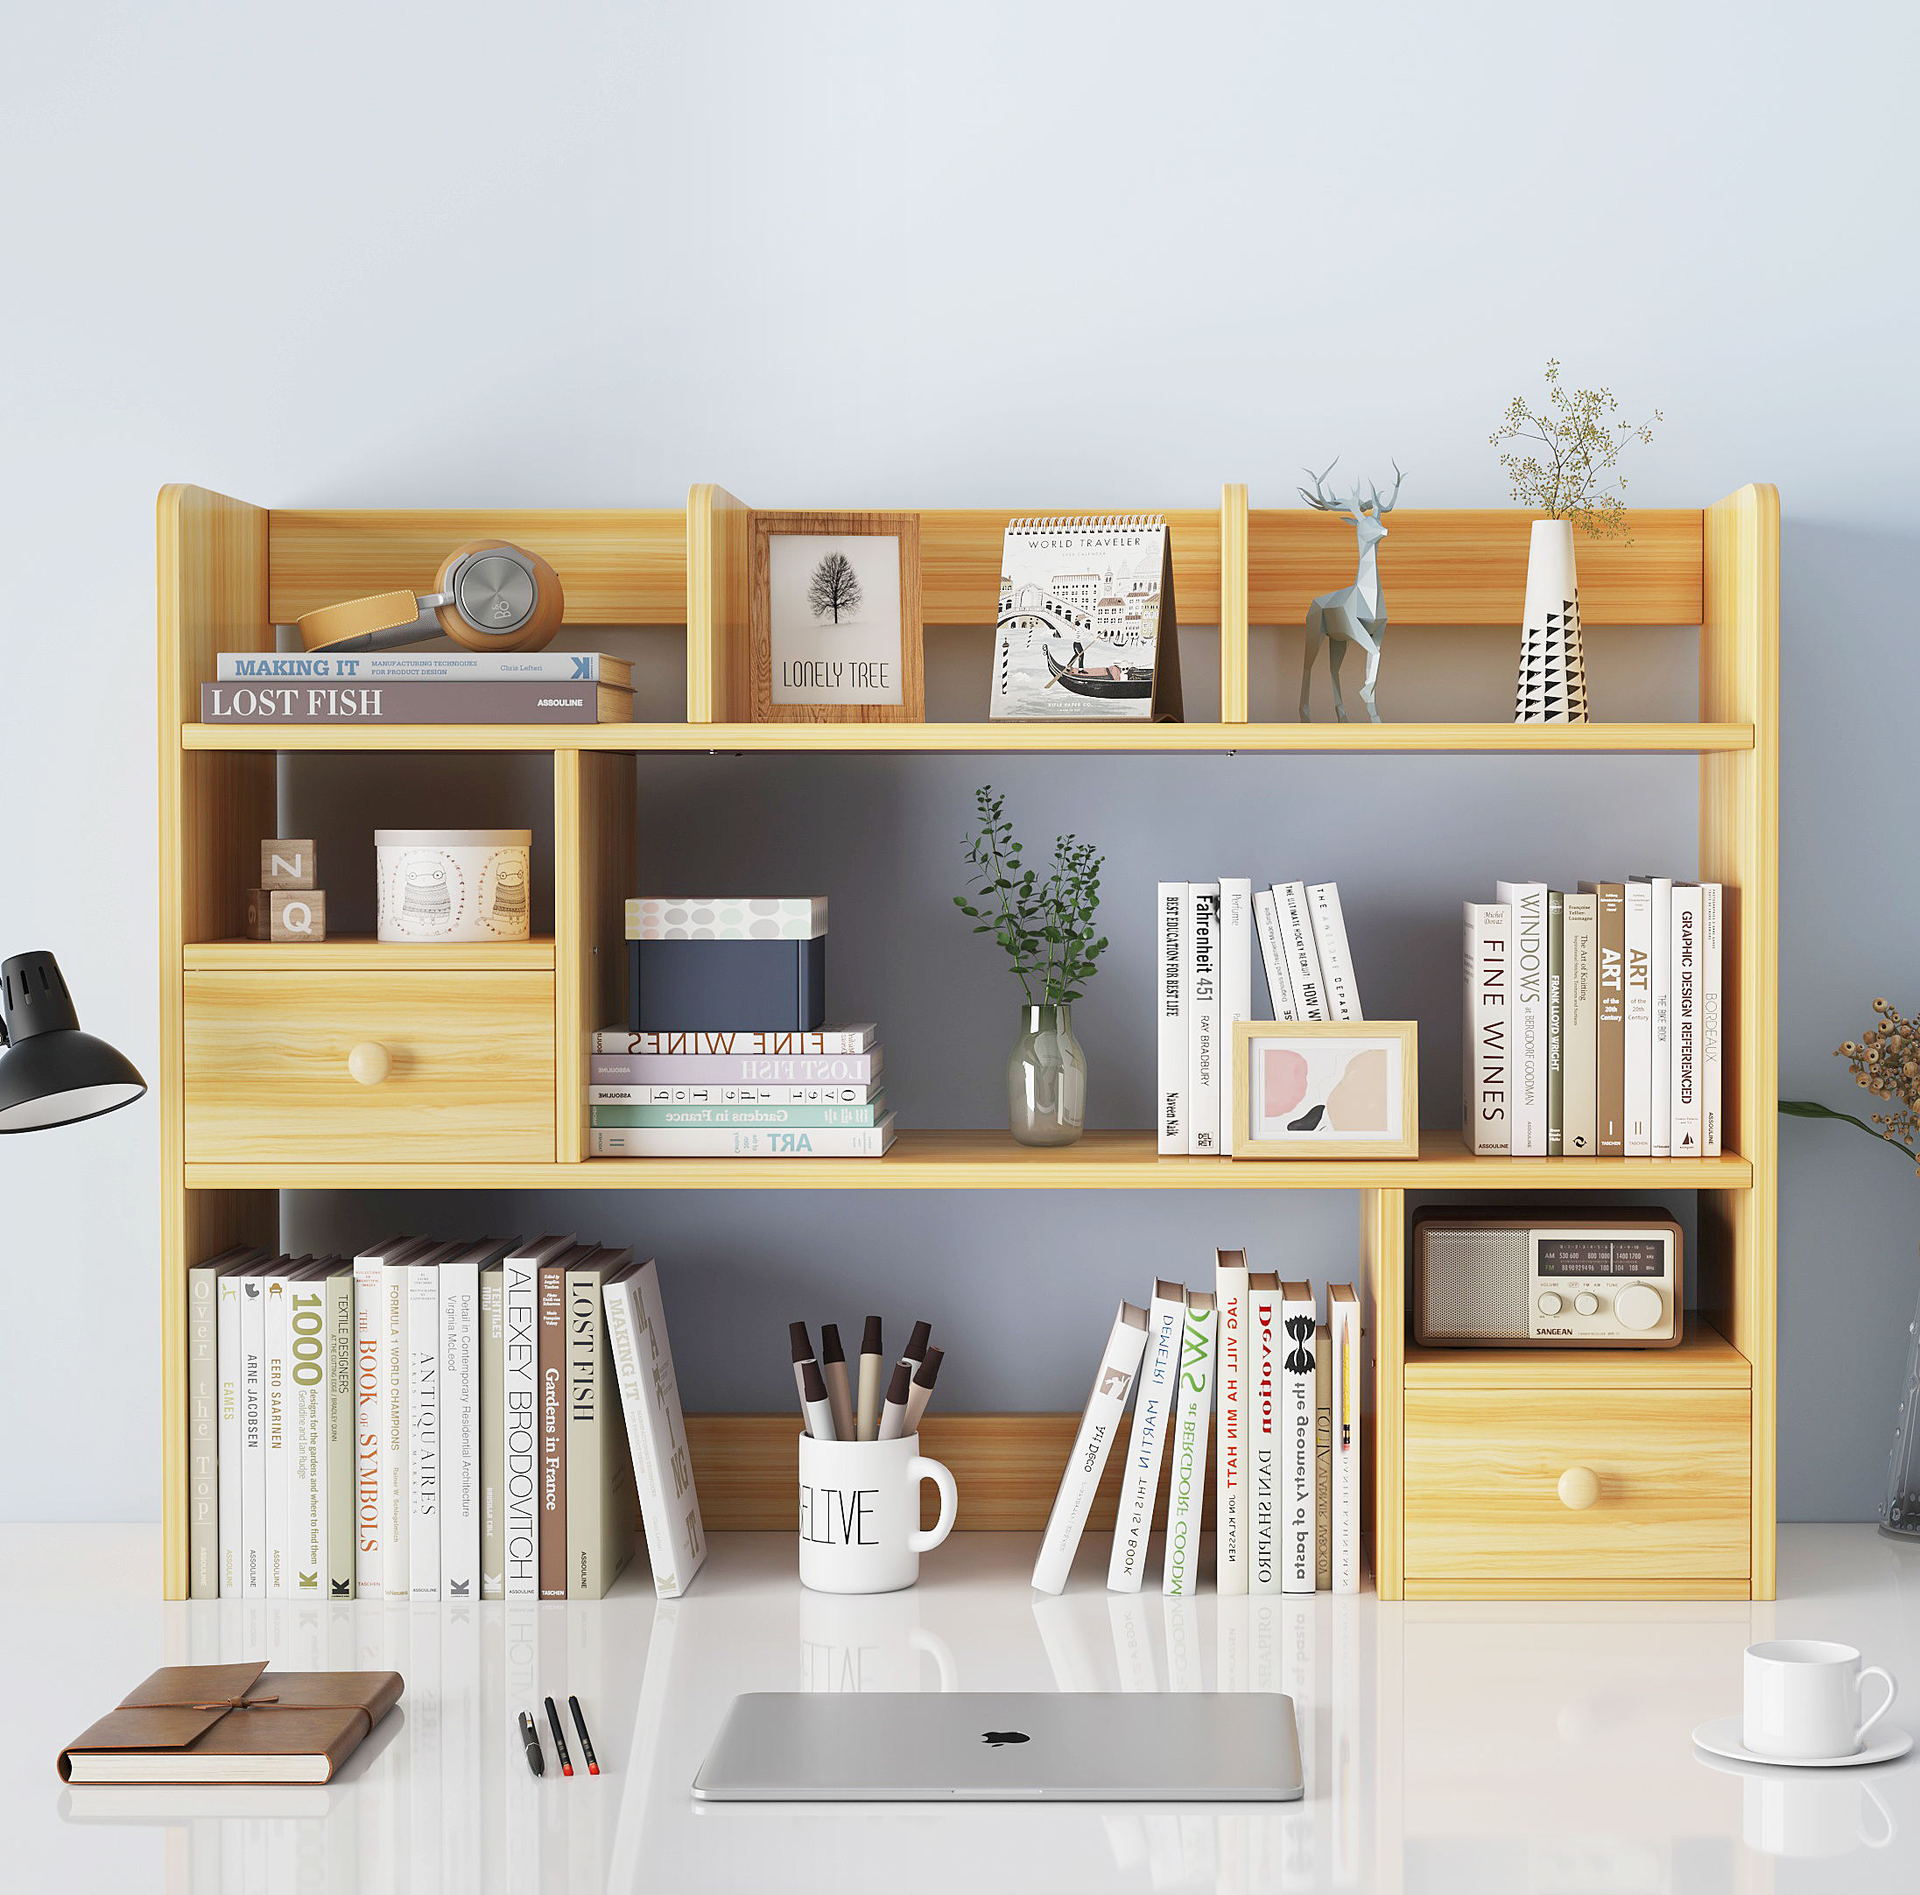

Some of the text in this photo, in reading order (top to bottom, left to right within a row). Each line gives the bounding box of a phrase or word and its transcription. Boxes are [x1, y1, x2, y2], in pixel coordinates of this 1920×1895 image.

[1028, 538, 1141, 549] WORLD TRAVELER
[211, 689, 384, 717] LOST FISH
[235, 660, 360, 676] MAKING IT
[500, 664, 518, 672] Chris
[537, 699, 583, 707] ASSOULINE
[783, 661, 891, 689] LONELY TREE
[283, 901, 313, 935] Q
[1231, 894, 1242, 926] Perfume
[1316, 888, 1327, 909] THE
[1166, 896, 1180, 1017] BEST EDUCATION FOR BEST LIFE
[1196, 895, 1213, 1001] Fahrenheit 451
[1602, 947, 1621, 991] ART
[1630, 948, 1648, 990] ART
[1681, 911, 1692, 967] GRAPHIC
[1302, 983, 1318, 1006] HOW
[1520, 893, 1540, 1106] WINDOWS BERGDORF GOODMAN
[1551, 975, 1560, 1072] FRANK LLOYD WRIGHT
[1658, 994, 1667, 1007] THE
[1681, 971, 1692, 1017] DESIGN
[1704, 993, 1718, 1064] BORDEAUX
[1200, 1015, 1210, 1087] RAY BRADBURY
[1483, 940, 1504, 1121] FINE WINES
[1681, 1022, 1692, 1104] REFERENCED
[1166, 1092, 1179, 1137] Naveen Naik
[292, 1292, 323, 1386] 1000
[338, 1294, 349, 1394] TEXTILE DESIGNERS
[446, 1295, 457, 1372] Virginia McLeod
[492, 1286, 502, 1338] TEXTILES
[1536, 1328, 1573, 1336] SANGEAN
[390, 1284, 400, 1451] FORMULA WORLD CHAMPIONS
[572, 1282, 594, 1423] LOST FISH
[608, 1298, 640, 1401] MAKING IT
[224, 1382, 234, 1420] EAMES
[247, 1354, 257, 1448] ARNE JACOBSEN
[271, 1358, 282, 1450] EERO SAARINEN
[299, 1390, 307, 1425] Geraldine
[359, 1310, 379, 1552] THE BOOK OF SYMBOLS
[416, 1352, 436, 1515] ANTIQUAIRES
[459, 1295, 472, 1517] Detail Contemporary Residential Architecture
[508, 1268, 533, 1579] ALEXEY BRODOVITCH
[545, 1368, 560, 1511] Gardens in France
[308, 1389, 319, 1565] designs for the gardens and where find them
